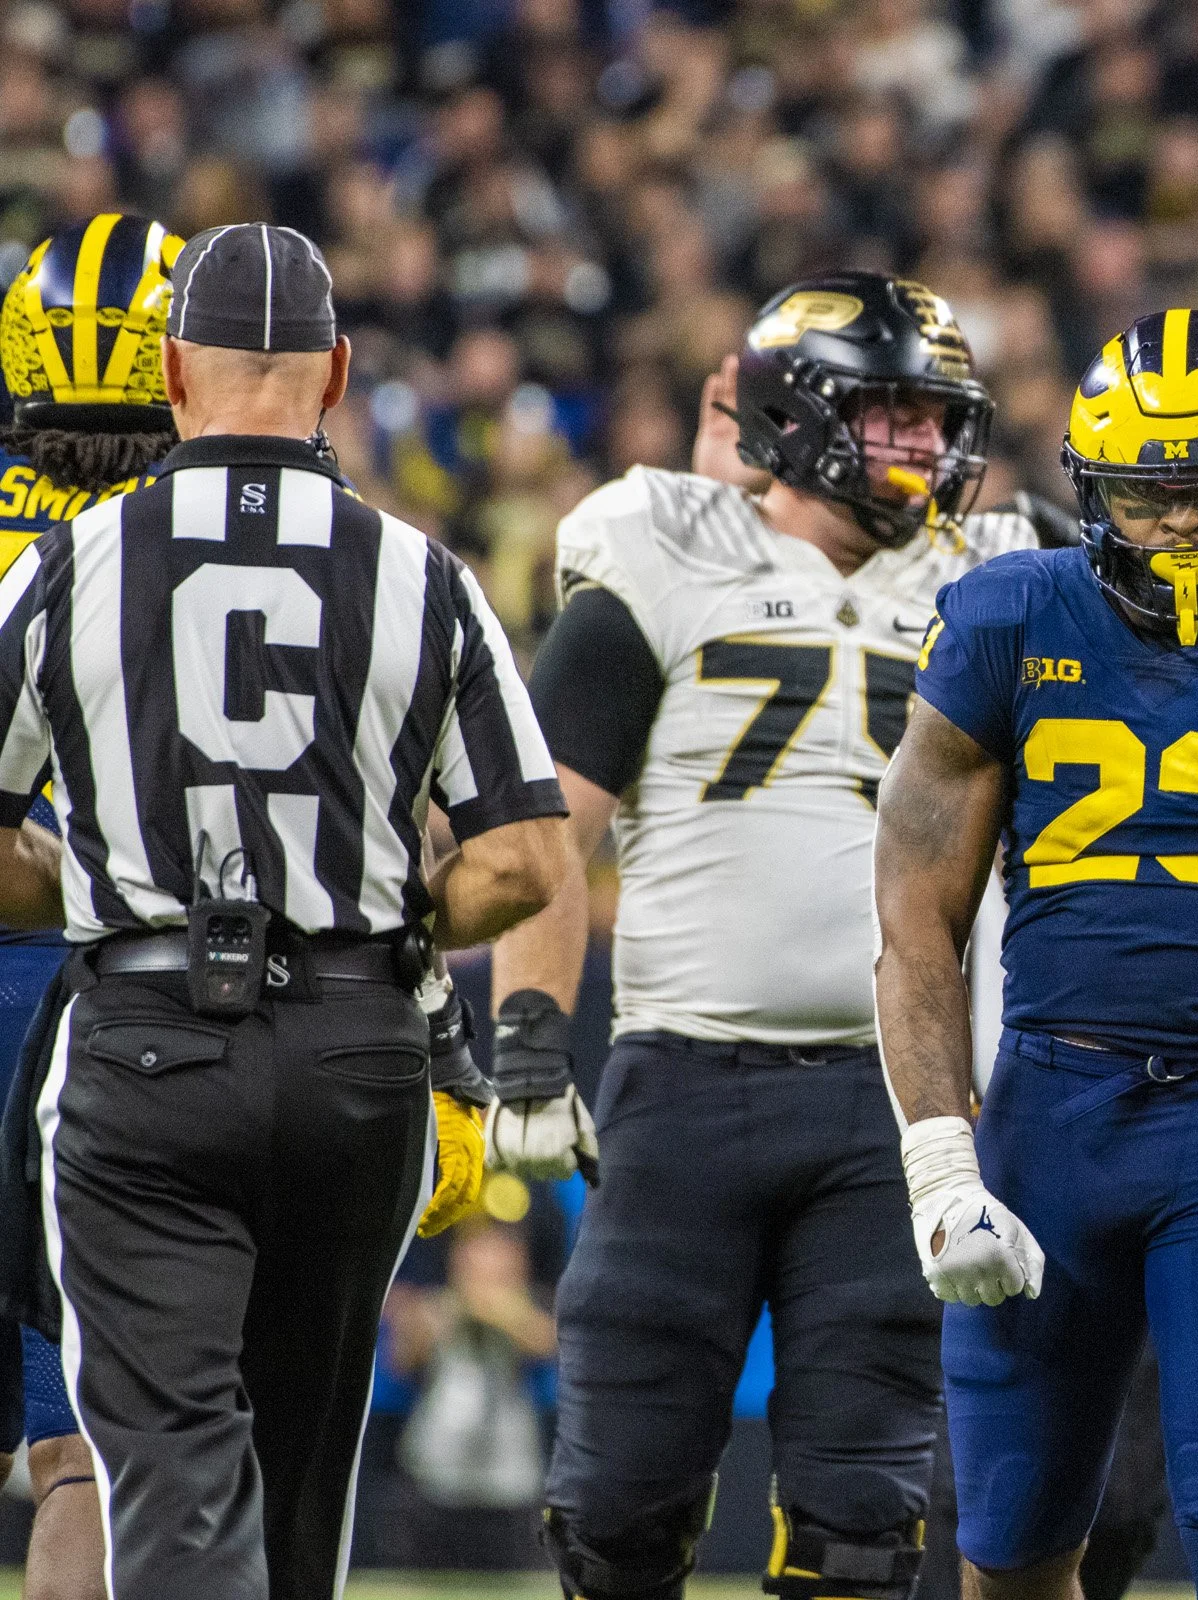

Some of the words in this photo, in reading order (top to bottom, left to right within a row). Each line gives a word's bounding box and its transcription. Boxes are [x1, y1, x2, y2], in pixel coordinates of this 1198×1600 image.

[1163, 440, 1189, 460] M
[1170, 552, 1198, 560] SHOCK
[172, 562, 323, 771] C
